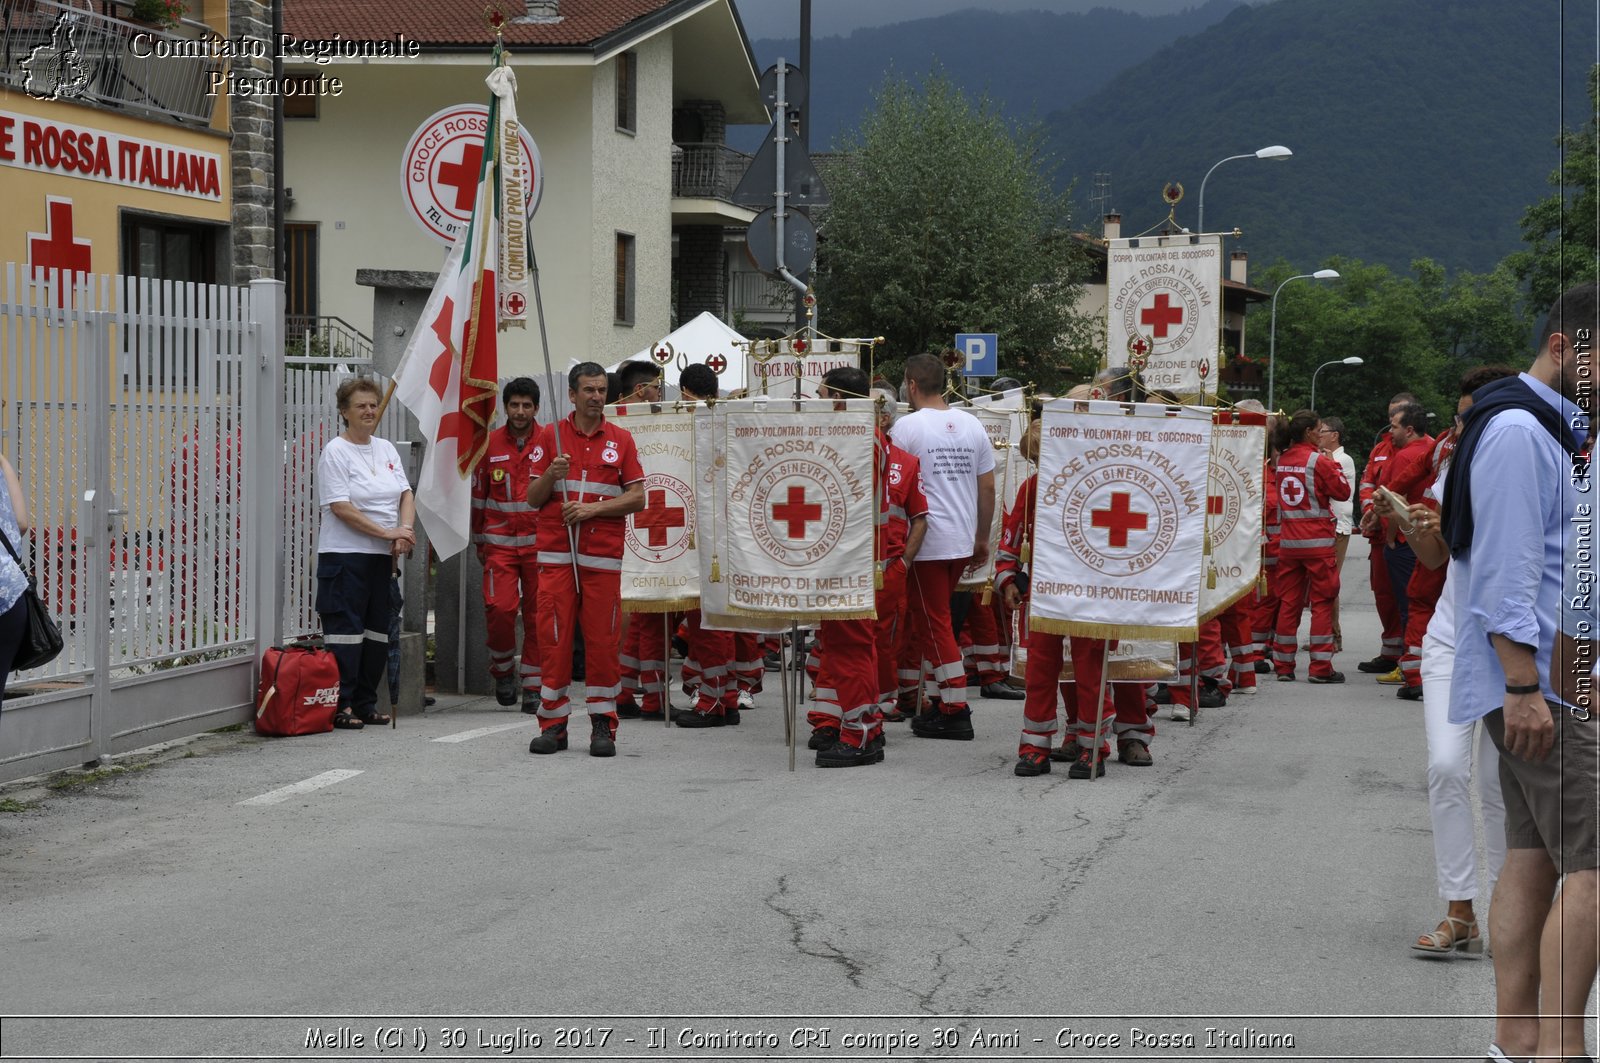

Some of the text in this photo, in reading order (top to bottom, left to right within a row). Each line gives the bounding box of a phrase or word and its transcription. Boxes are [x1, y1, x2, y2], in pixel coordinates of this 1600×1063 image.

[412, 118, 488, 183] CROCE ROSS
[504, 119, 520, 166] CUNEO
[23, 121, 112, 177] ROSSA
[118, 140, 221, 197] ITALIANA
[426, 205, 443, 228] TEL.
[507, 218, 525, 282] COMITATO
[1113, 254, 1133, 263] CORPO
[1134, 252, 1167, 263] VOLONTARI
[1168, 251, 1180, 260] DEL
[1114, 263, 1211, 310] CROCE ROSSA ITALIANA
[1144, 278, 1179, 291] GINEVRA
[1179, 286, 1191, 298] 22
[1188, 299, 1197, 334] AGOSTO
[965, 338, 986, 371] P
[735, 425, 866, 437] CORPO VOLONTARI DEL SOCCORSO
[1049, 426, 1203, 444] CORPO VOLONTARI DEL SOCCORSO
[731, 440, 866, 503] CROCE ROSSA ITALIANA
[766, 471, 777, 485] DI
[780, 463, 828, 483] GINEVRA
[1043, 444, 1200, 515] CROCE ROSSA ITALIANA
[1085, 476, 1099, 490] DI
[1102, 467, 1157, 491] GINEVRA
[1218, 447, 1257, 500] ITALIANA
[676, 484, 688, 495] 22
[827, 482, 839, 497] 22
[1225, 480, 1236, 492] 22
[1156, 491, 1171, 507] 22
[753, 486, 786, 560] CONVENZIONE
[826, 500, 843, 541] AGOSTO
[1225, 495, 1238, 528] AGOSTO
[1066, 490, 1105, 569] CONVENZIONE
[1154, 509, 1175, 552] AGOSTO
[632, 575, 687, 588] CENTALLO
[732, 573, 791, 590] GRUPPO
[797, 578, 810, 590] DI
[816, 575, 868, 590] MELLE
[1036, 581, 1083, 597] GRUPPO
[1086, 585, 1097, 598] DI
[735, 589, 865, 608] COMITATO LOCALE
